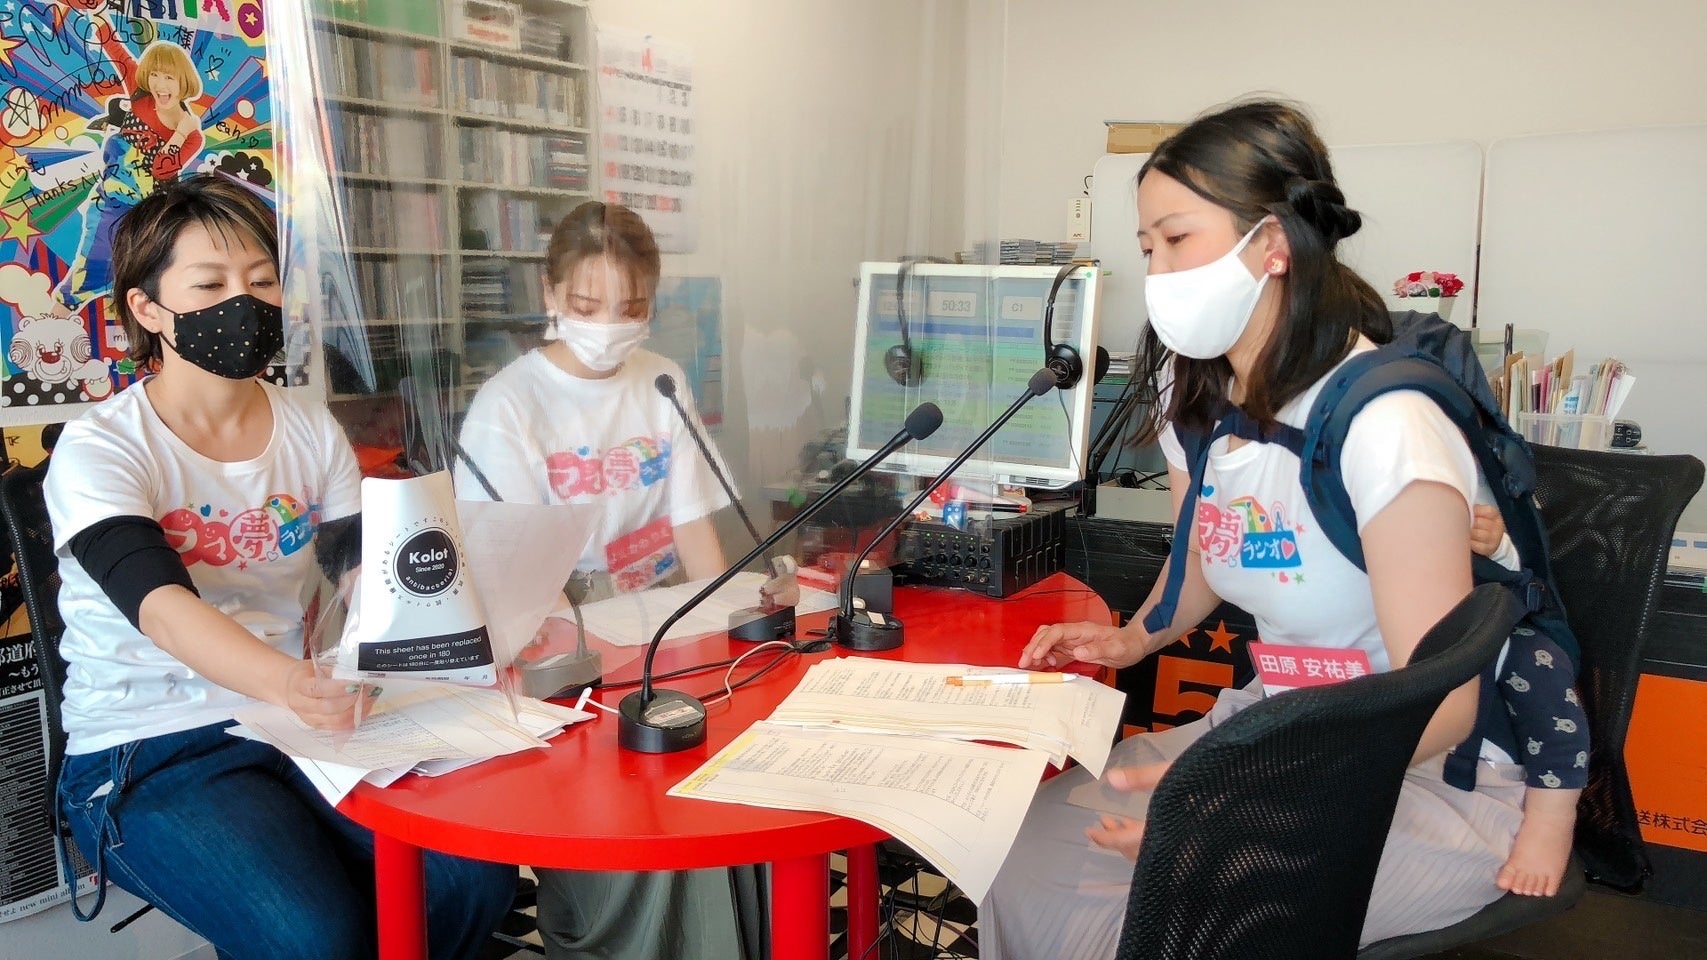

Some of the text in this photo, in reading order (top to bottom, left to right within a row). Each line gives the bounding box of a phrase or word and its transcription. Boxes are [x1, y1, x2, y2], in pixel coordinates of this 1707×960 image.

[6, 177, 79, 215] Thanks
[409, 548, 448, 565] Kolot
[393, 646, 414, 654] sheet
[415, 644, 430, 652] has
[431, 642, 450, 650] been
[451, 636, 482, 647] replaced
[1259, 655, 1367, 680] 田原 安祐美
[1153, 655, 1234, 717] 5
